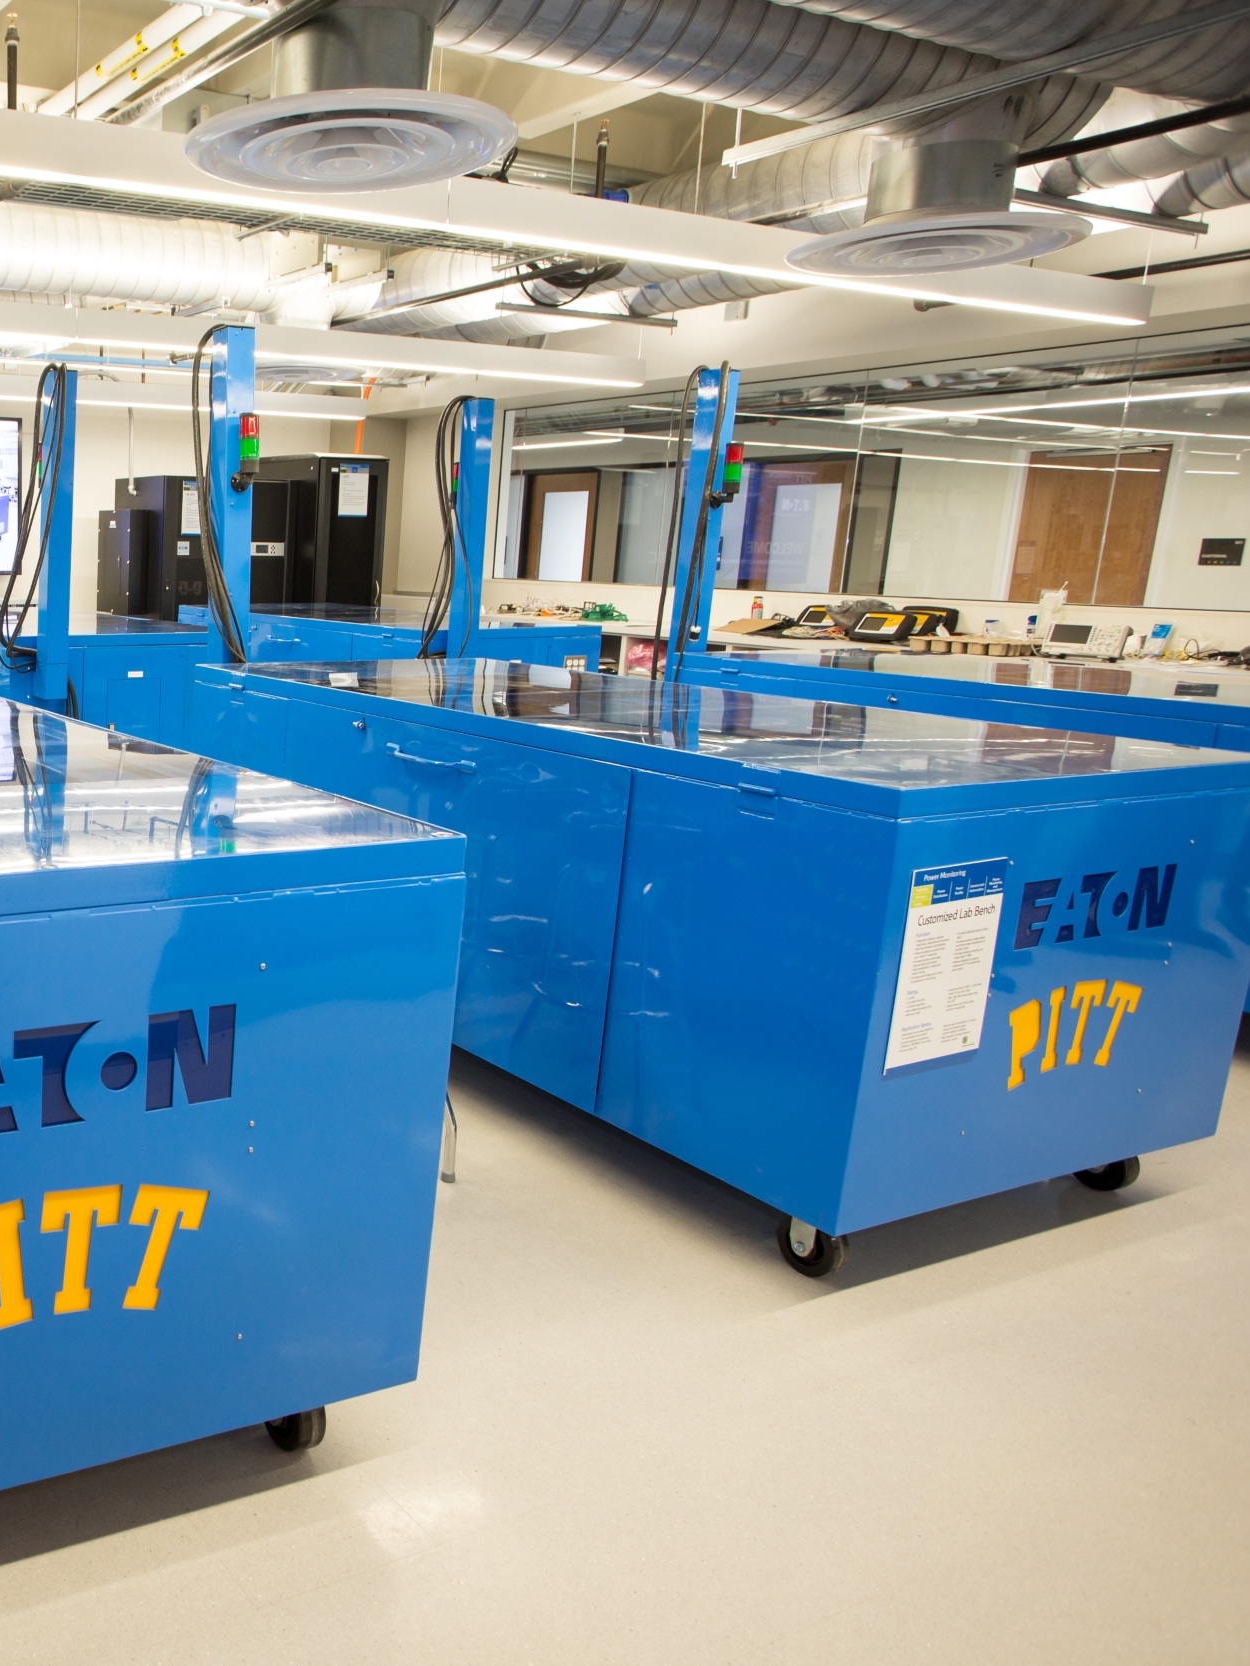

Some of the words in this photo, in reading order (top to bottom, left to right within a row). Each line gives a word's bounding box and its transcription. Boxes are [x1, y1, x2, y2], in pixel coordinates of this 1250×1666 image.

[923, 873, 939, 882] Power
[939, 870, 967, 880] Monitoring
[917, 909, 958, 926] Customized
[959, 906, 973, 919] Lab
[974, 903, 996, 917] Bench
[1014, 863, 1178, 951] EATON
[1007, 979, 1143, 1091] PITT
